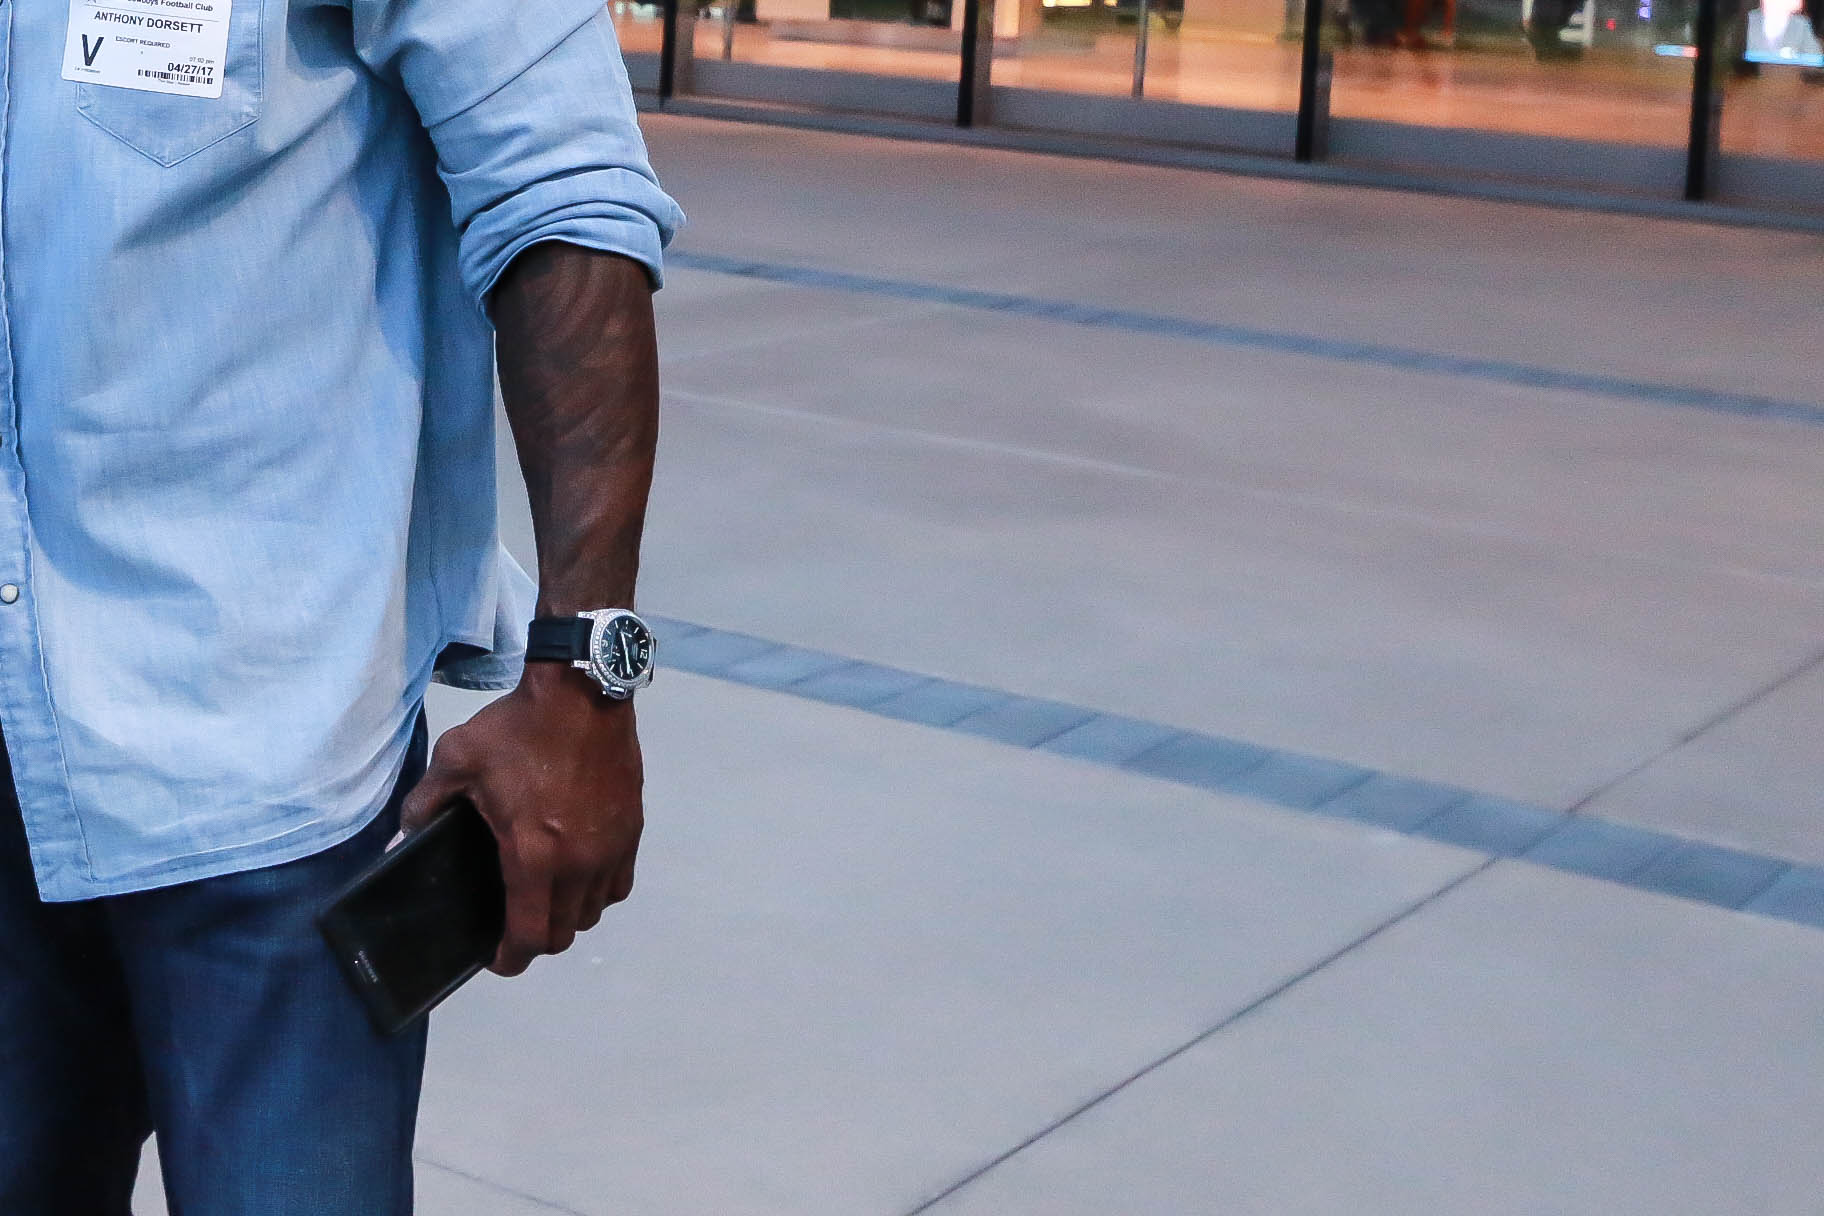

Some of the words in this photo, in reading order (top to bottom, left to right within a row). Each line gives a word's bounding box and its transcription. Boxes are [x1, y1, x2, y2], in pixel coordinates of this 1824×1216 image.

[160, 0, 193, 9] Football
[195, 3, 213, 12] Club
[94, 10, 144, 27] ANTHONY
[147, 17, 203, 34] DORSETT
[81, 34, 104, 66] V
[139, 39, 171, 48] REQUIRED
[167, 62, 214, 77] 04/27/17
